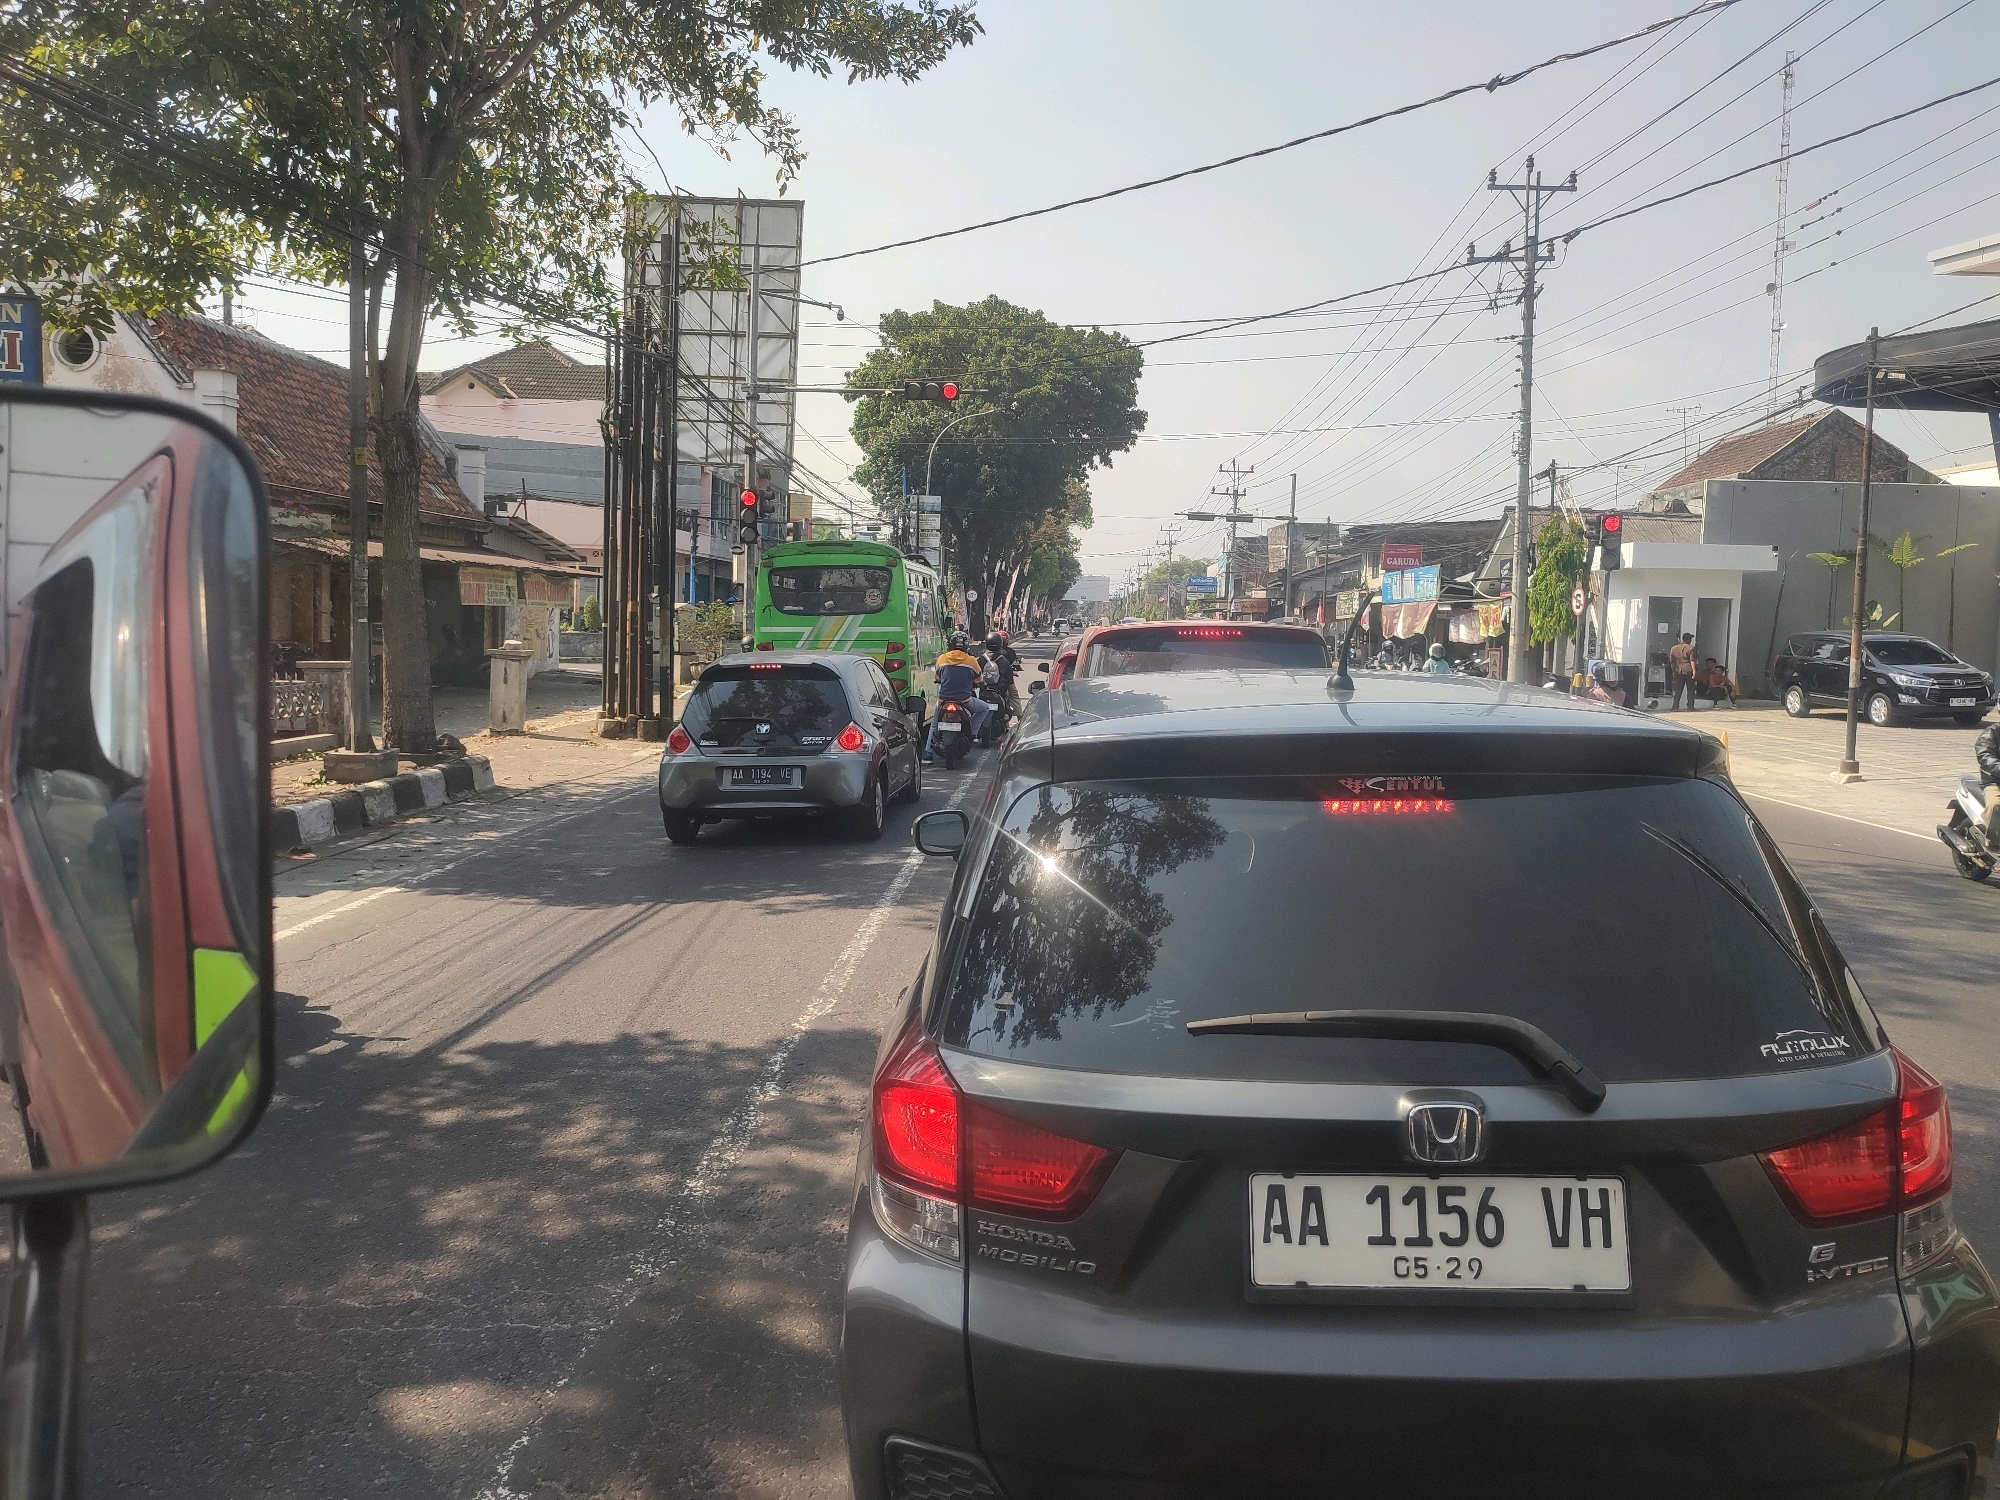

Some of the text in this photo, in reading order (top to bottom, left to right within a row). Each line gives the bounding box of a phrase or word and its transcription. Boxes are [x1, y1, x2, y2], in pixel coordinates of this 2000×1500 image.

[1386, 557, 1420, 566] GARUDA
[732, 768, 791, 780] AA 1194 VE
[1760, 1036, 1850, 1057] AUTOLUX
[1816, 1050, 1845, 1058] DETAILING
[1263, 1183, 1613, 1249] AA 1156 VH
[977, 1220, 1076, 1251] HONDA
[977, 1243, 1097, 1274] MOBILIO
